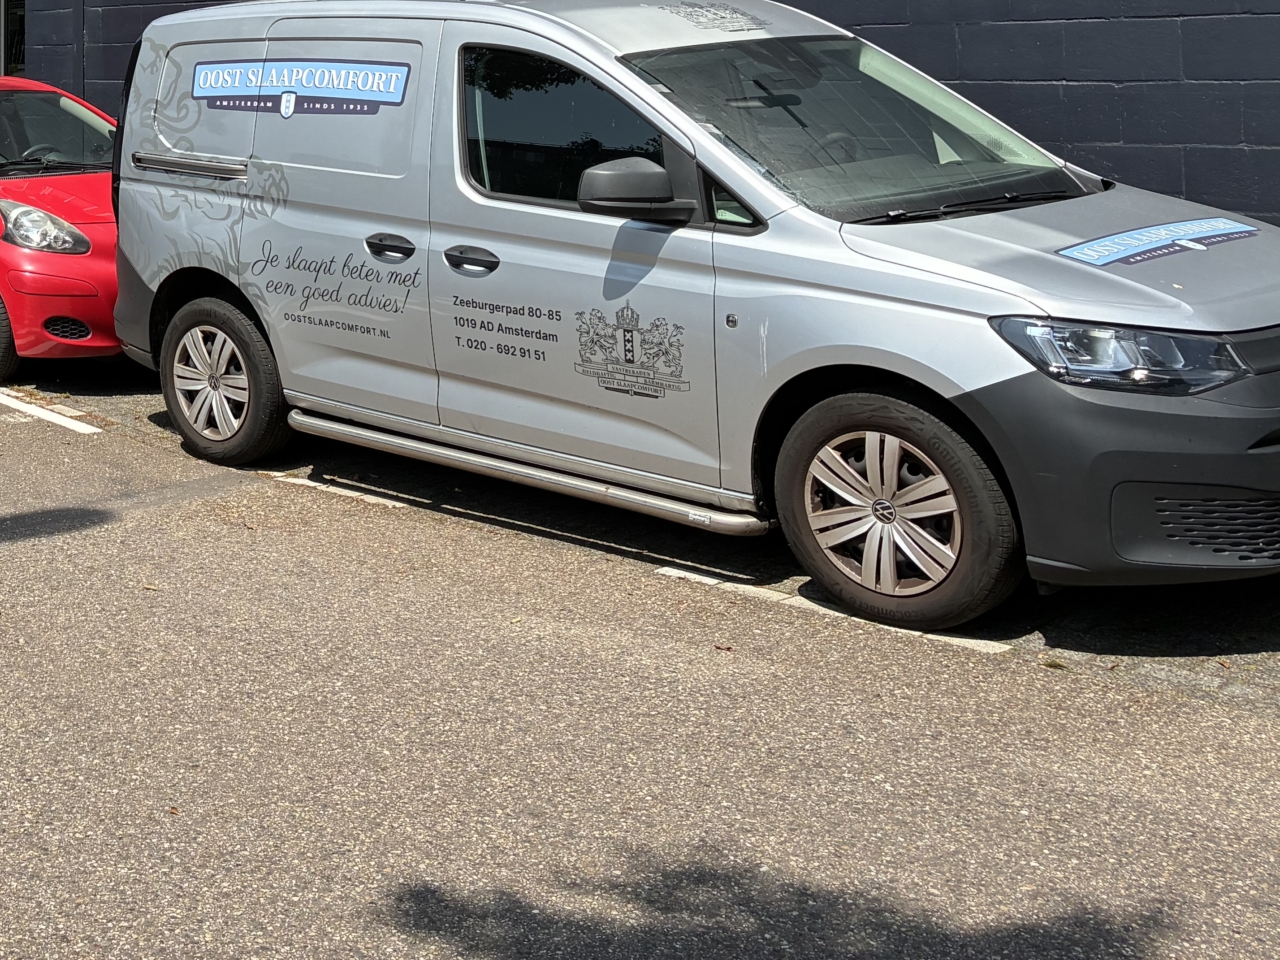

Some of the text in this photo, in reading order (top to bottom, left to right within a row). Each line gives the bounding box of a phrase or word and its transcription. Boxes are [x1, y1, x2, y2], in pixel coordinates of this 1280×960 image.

[199, 67, 402, 93] OOST SLAAPCOMFORT
[303, 102, 336, 110] SINDS
[343, 103, 368, 111] 1935
[1073, 240, 1122, 261] OOST
[251, 239, 422, 289] Je slaapt beter met
[265, 279, 411, 314] een goed advies!
[452, 295, 562, 322] Zeeburgerpad 80-85
[284, 312, 391, 339] OOSTSLAAPCOMFORT.NL
[453, 316, 559, 343] 1019 AD Amsterdam
[496, 343, 517, 357] 692
[519, 347, 531, 359] 91
[534, 350, 546, 361] 51
[600, 379, 615, 387] OOST
[616, 382, 663, 395] SLAAPCOMFORT
